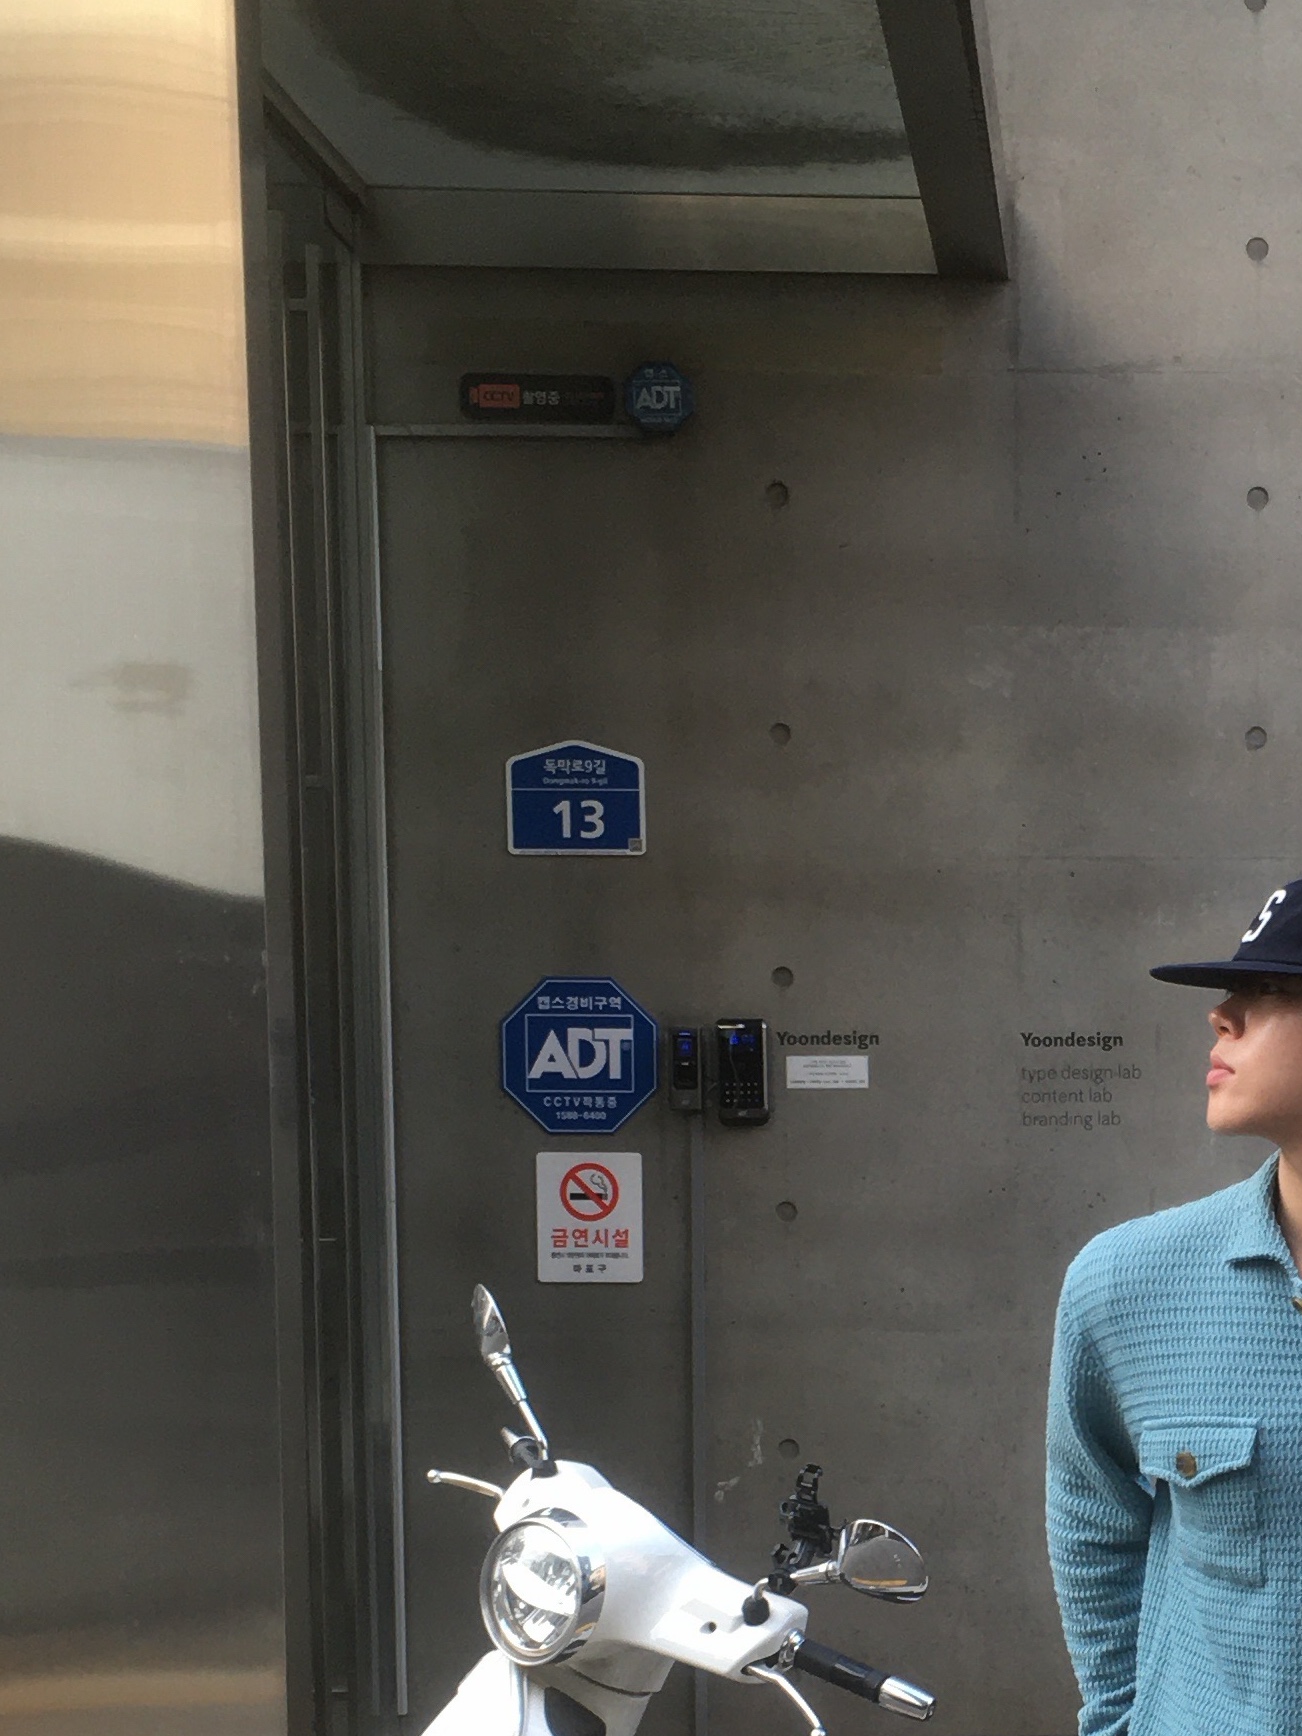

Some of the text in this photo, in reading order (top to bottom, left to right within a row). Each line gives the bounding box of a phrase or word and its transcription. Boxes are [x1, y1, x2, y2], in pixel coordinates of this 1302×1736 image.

[636, 386, 682, 410] ADT
[543, 758, 606, 775] 독막로9길
[553, 800, 605, 839] 13
[1241, 889, 1287, 943] S
[537, 996, 622, 1011] 캡스경비구역
[776, 1030, 880, 1050] Yoondesign
[1020, 1031, 1124, 1051] Yoondesign
[528, 1028, 633, 1079] ADT
[1021, 1064, 1142, 1084] type design lab
[1021, 1087, 1113, 1103] content lab
[1022, 1110, 1121, 1131] branding lab
[551, 1227, 629, 1248] 금연시설
